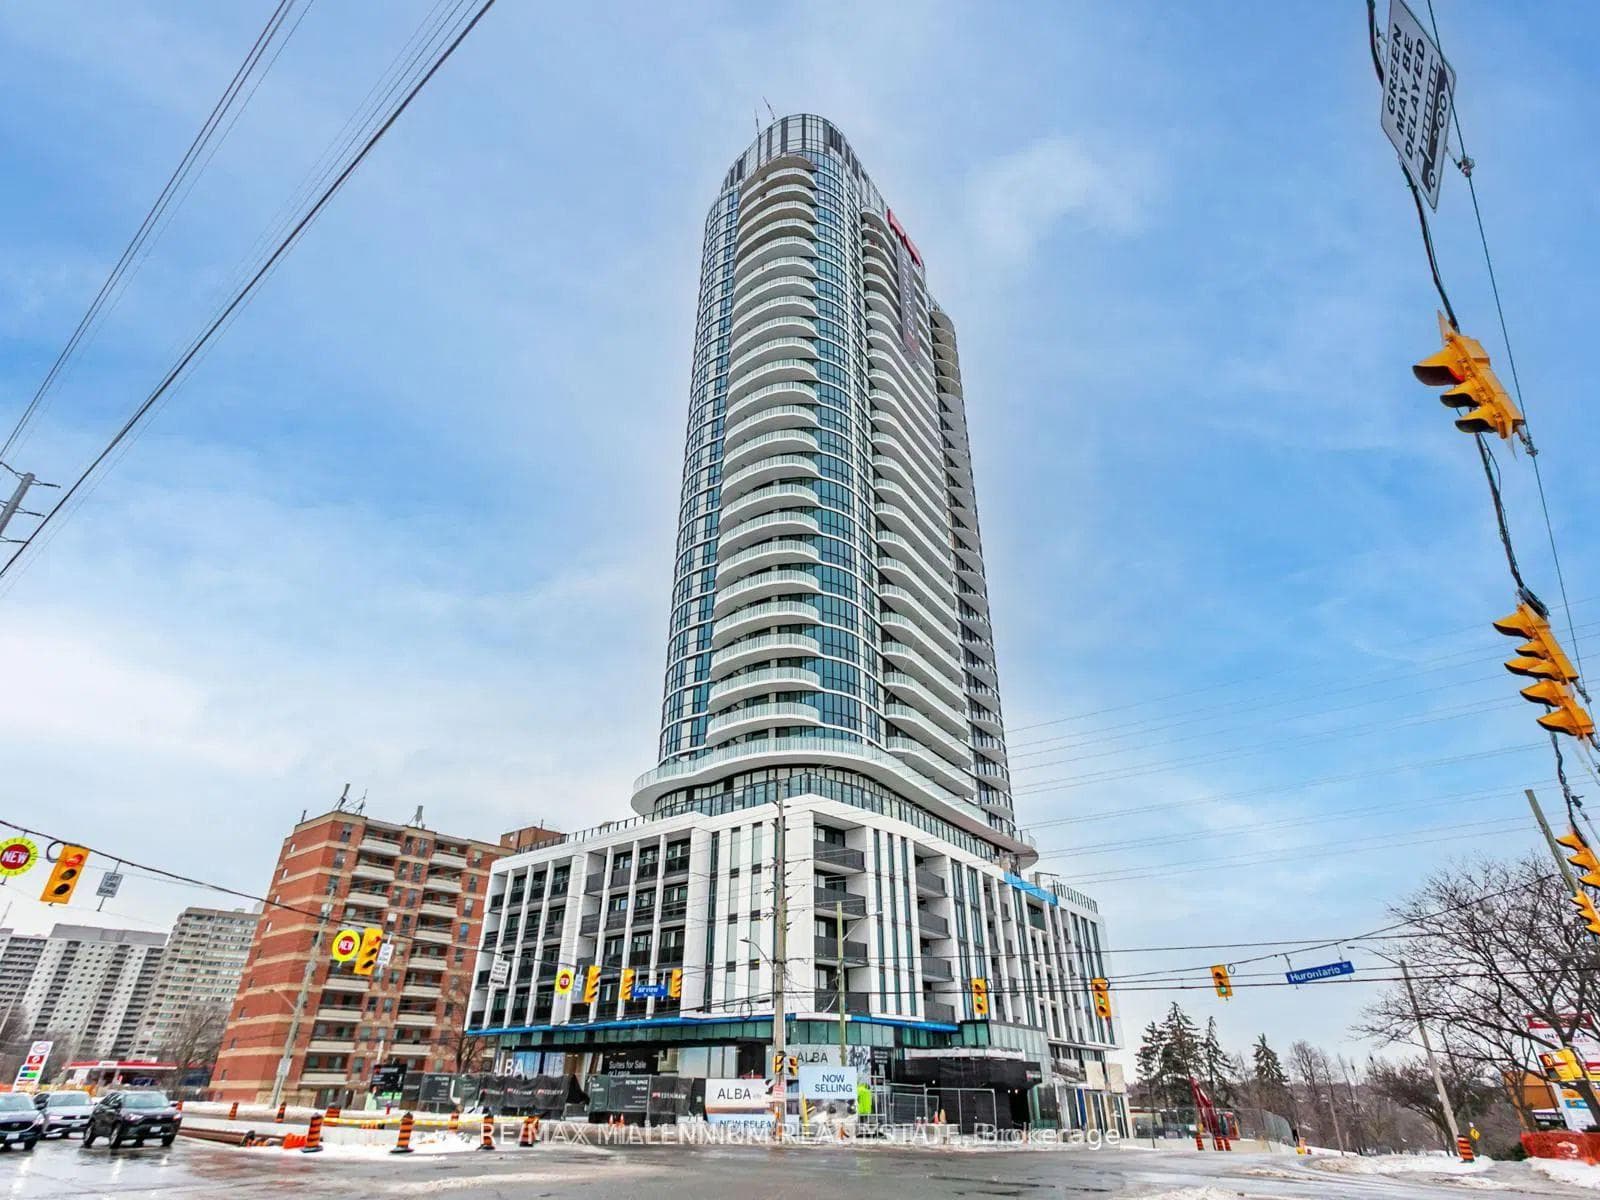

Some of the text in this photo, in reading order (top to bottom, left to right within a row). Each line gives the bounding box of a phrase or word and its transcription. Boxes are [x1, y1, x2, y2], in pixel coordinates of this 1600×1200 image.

[1387, 23, 1402, 116] GREEN
[1396, 31, 1413, 136] MAY BE
[1405, 38, 1425, 161] DELAYED
[1, 850, 29, 864] NEW
[338, 940, 354, 950] NEW
[1289, 966, 1341, 981] Hurontario
[797, 1052, 829, 1063] ALBA
[608, 1060, 647, 1069] Suites for Sale
[822, 1074, 845, 1083] NOW
[717, 1087, 752, 1100] ALBA
[814, 1084, 853, 1093] SELLING
